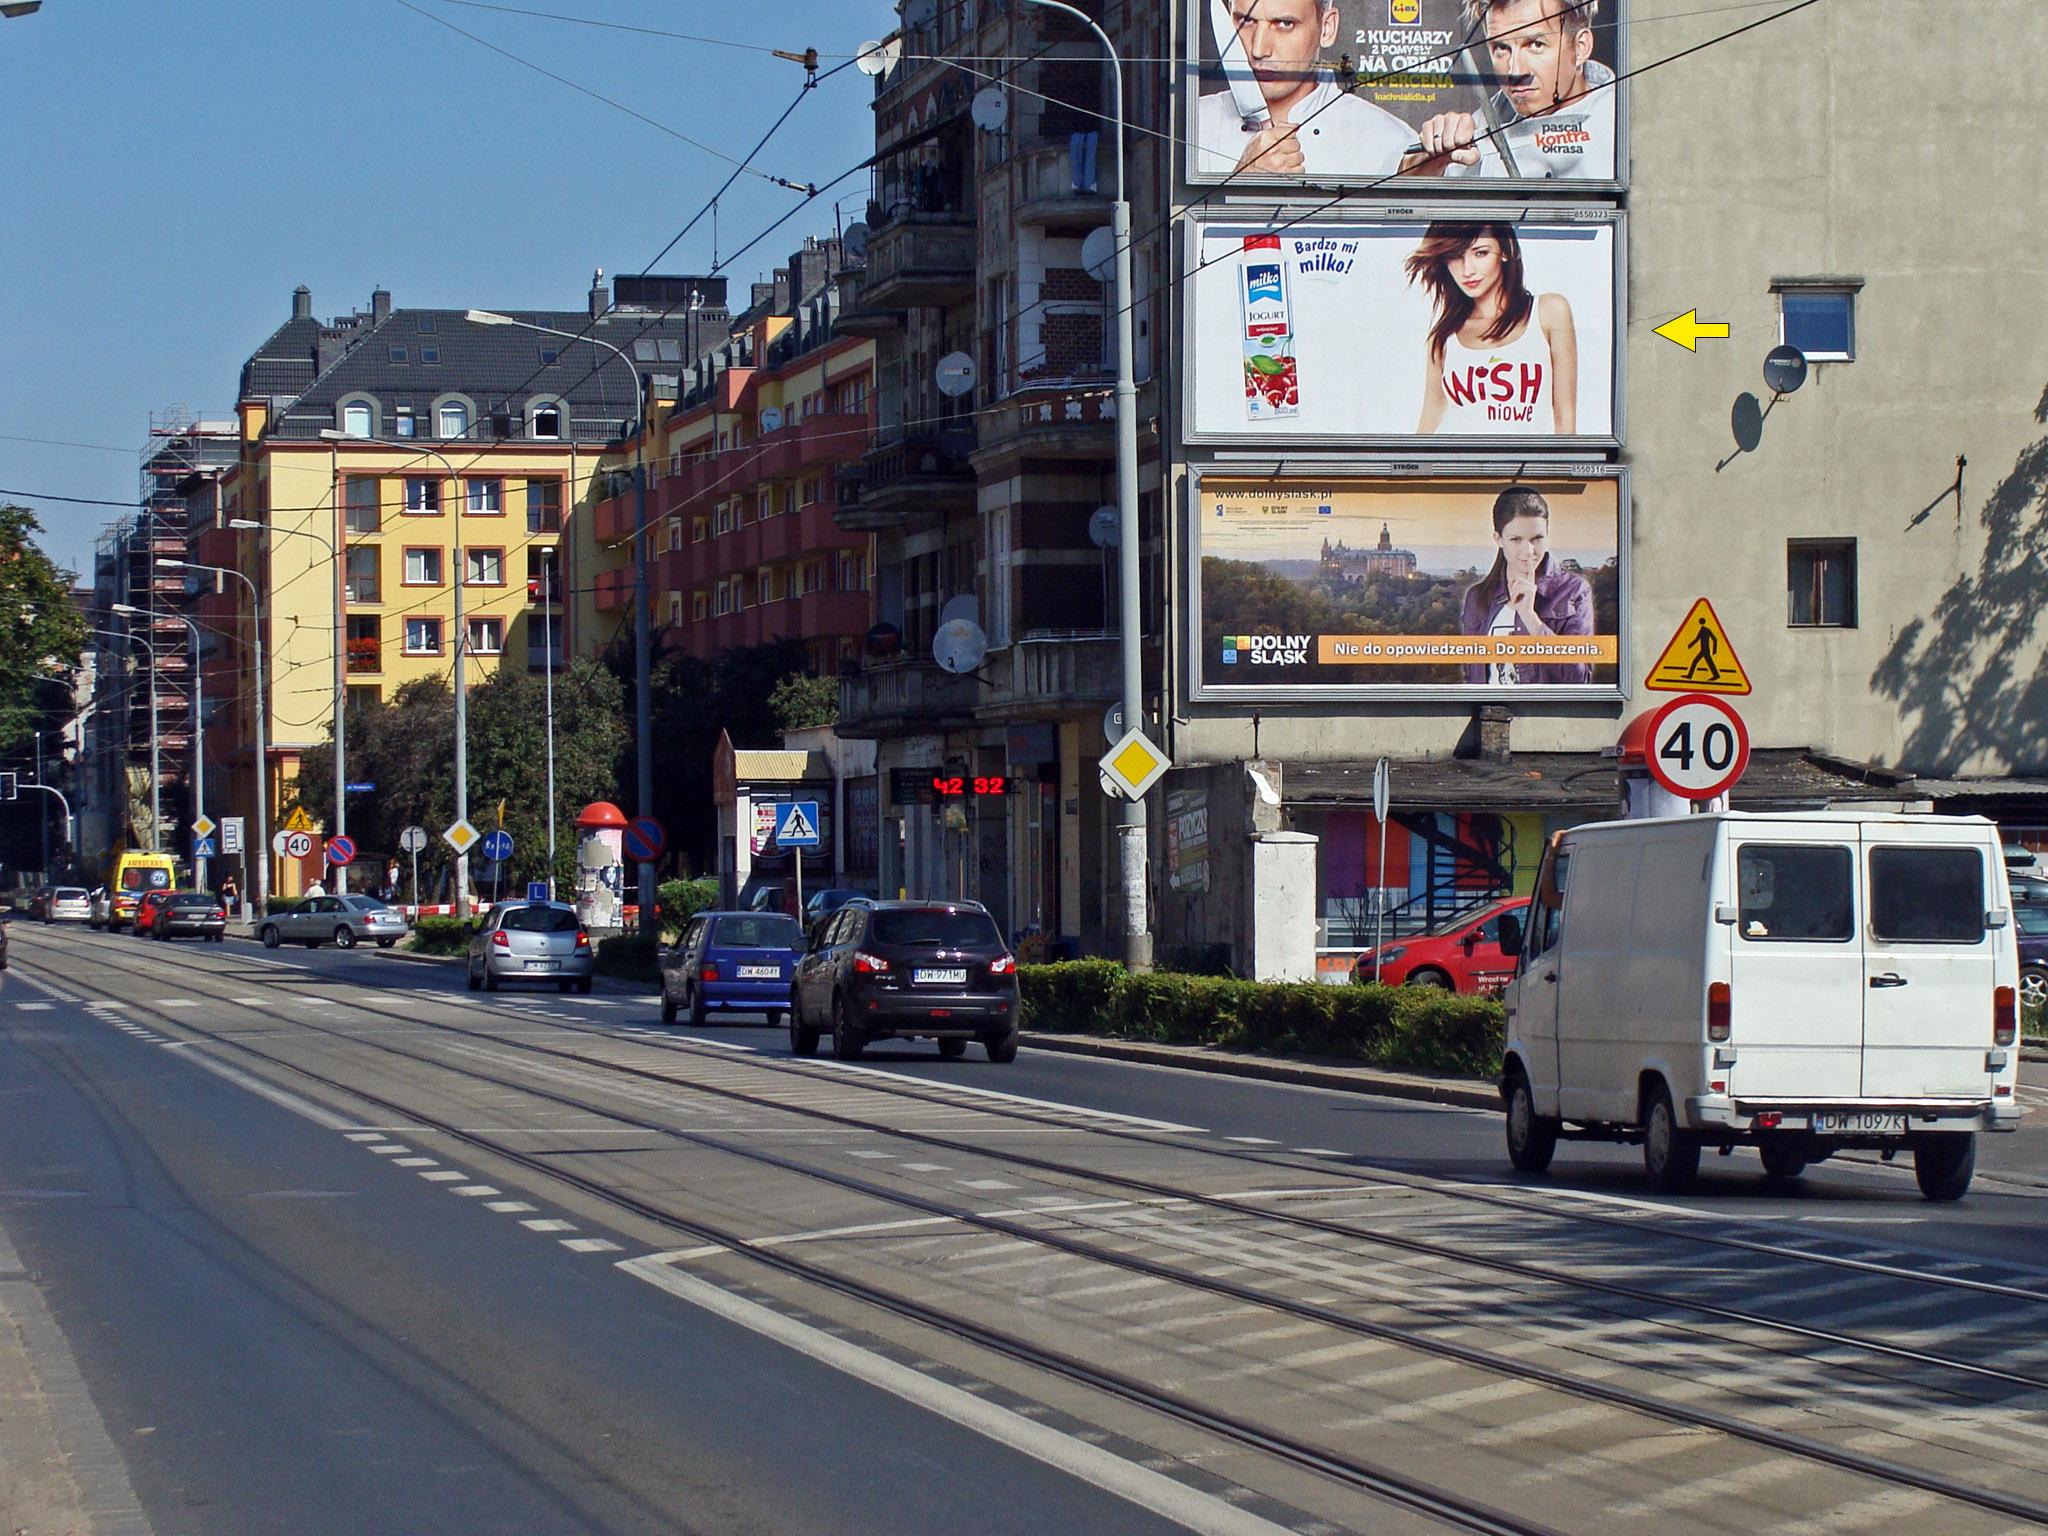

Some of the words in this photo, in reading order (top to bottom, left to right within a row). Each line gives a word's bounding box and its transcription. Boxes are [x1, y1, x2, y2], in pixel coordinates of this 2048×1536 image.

[1356, 30, 1366, 44] 2
[1367, 30, 1453, 45] KUCHARZY
[1371, 45, 1380, 55] 2
[1381, 45, 1433, 55] POMYSŁY
[1359, 55, 1388, 73] NA
[1391, 56, 1453, 74] OBIAD
[1356, 73, 1455, 89] SUPERCENA
[1542, 122, 1582, 135] pascal
[1535, 131, 1590, 147] kontra
[1542, 143, 1584, 154] okrasa
[1294, 237, 1338, 255] Bardzo
[1341, 241, 1359, 254] mi
[1299, 252, 1354, 275] milko!
[1249, 272, 1279, 289] milko
[1249, 310, 1286, 322] JOGURT
[1487, 403, 1533, 422] niowe
[1215, 488, 1333, 501] www.dolnyslask.pl
[1250, 635, 1311, 650] DOLNY
[1335, 643, 1359, 656] Nie
[1363, 642, 1381, 656] do
[1386, 642, 1491, 659] opowiedzenia.
[1496, 643, 1515, 656] Do
[1519, 642, 1603, 656] zobaczenia.
[1250, 648, 1308, 666] ŚLĄSK
[1660, 722, 1735, 772] 40
[290, 838, 310, 851] 40
[534, 886, 543, 899] L
[1825, 1114, 1849, 1129] DW
[1856, 1114, 1902, 1130] 1097K
